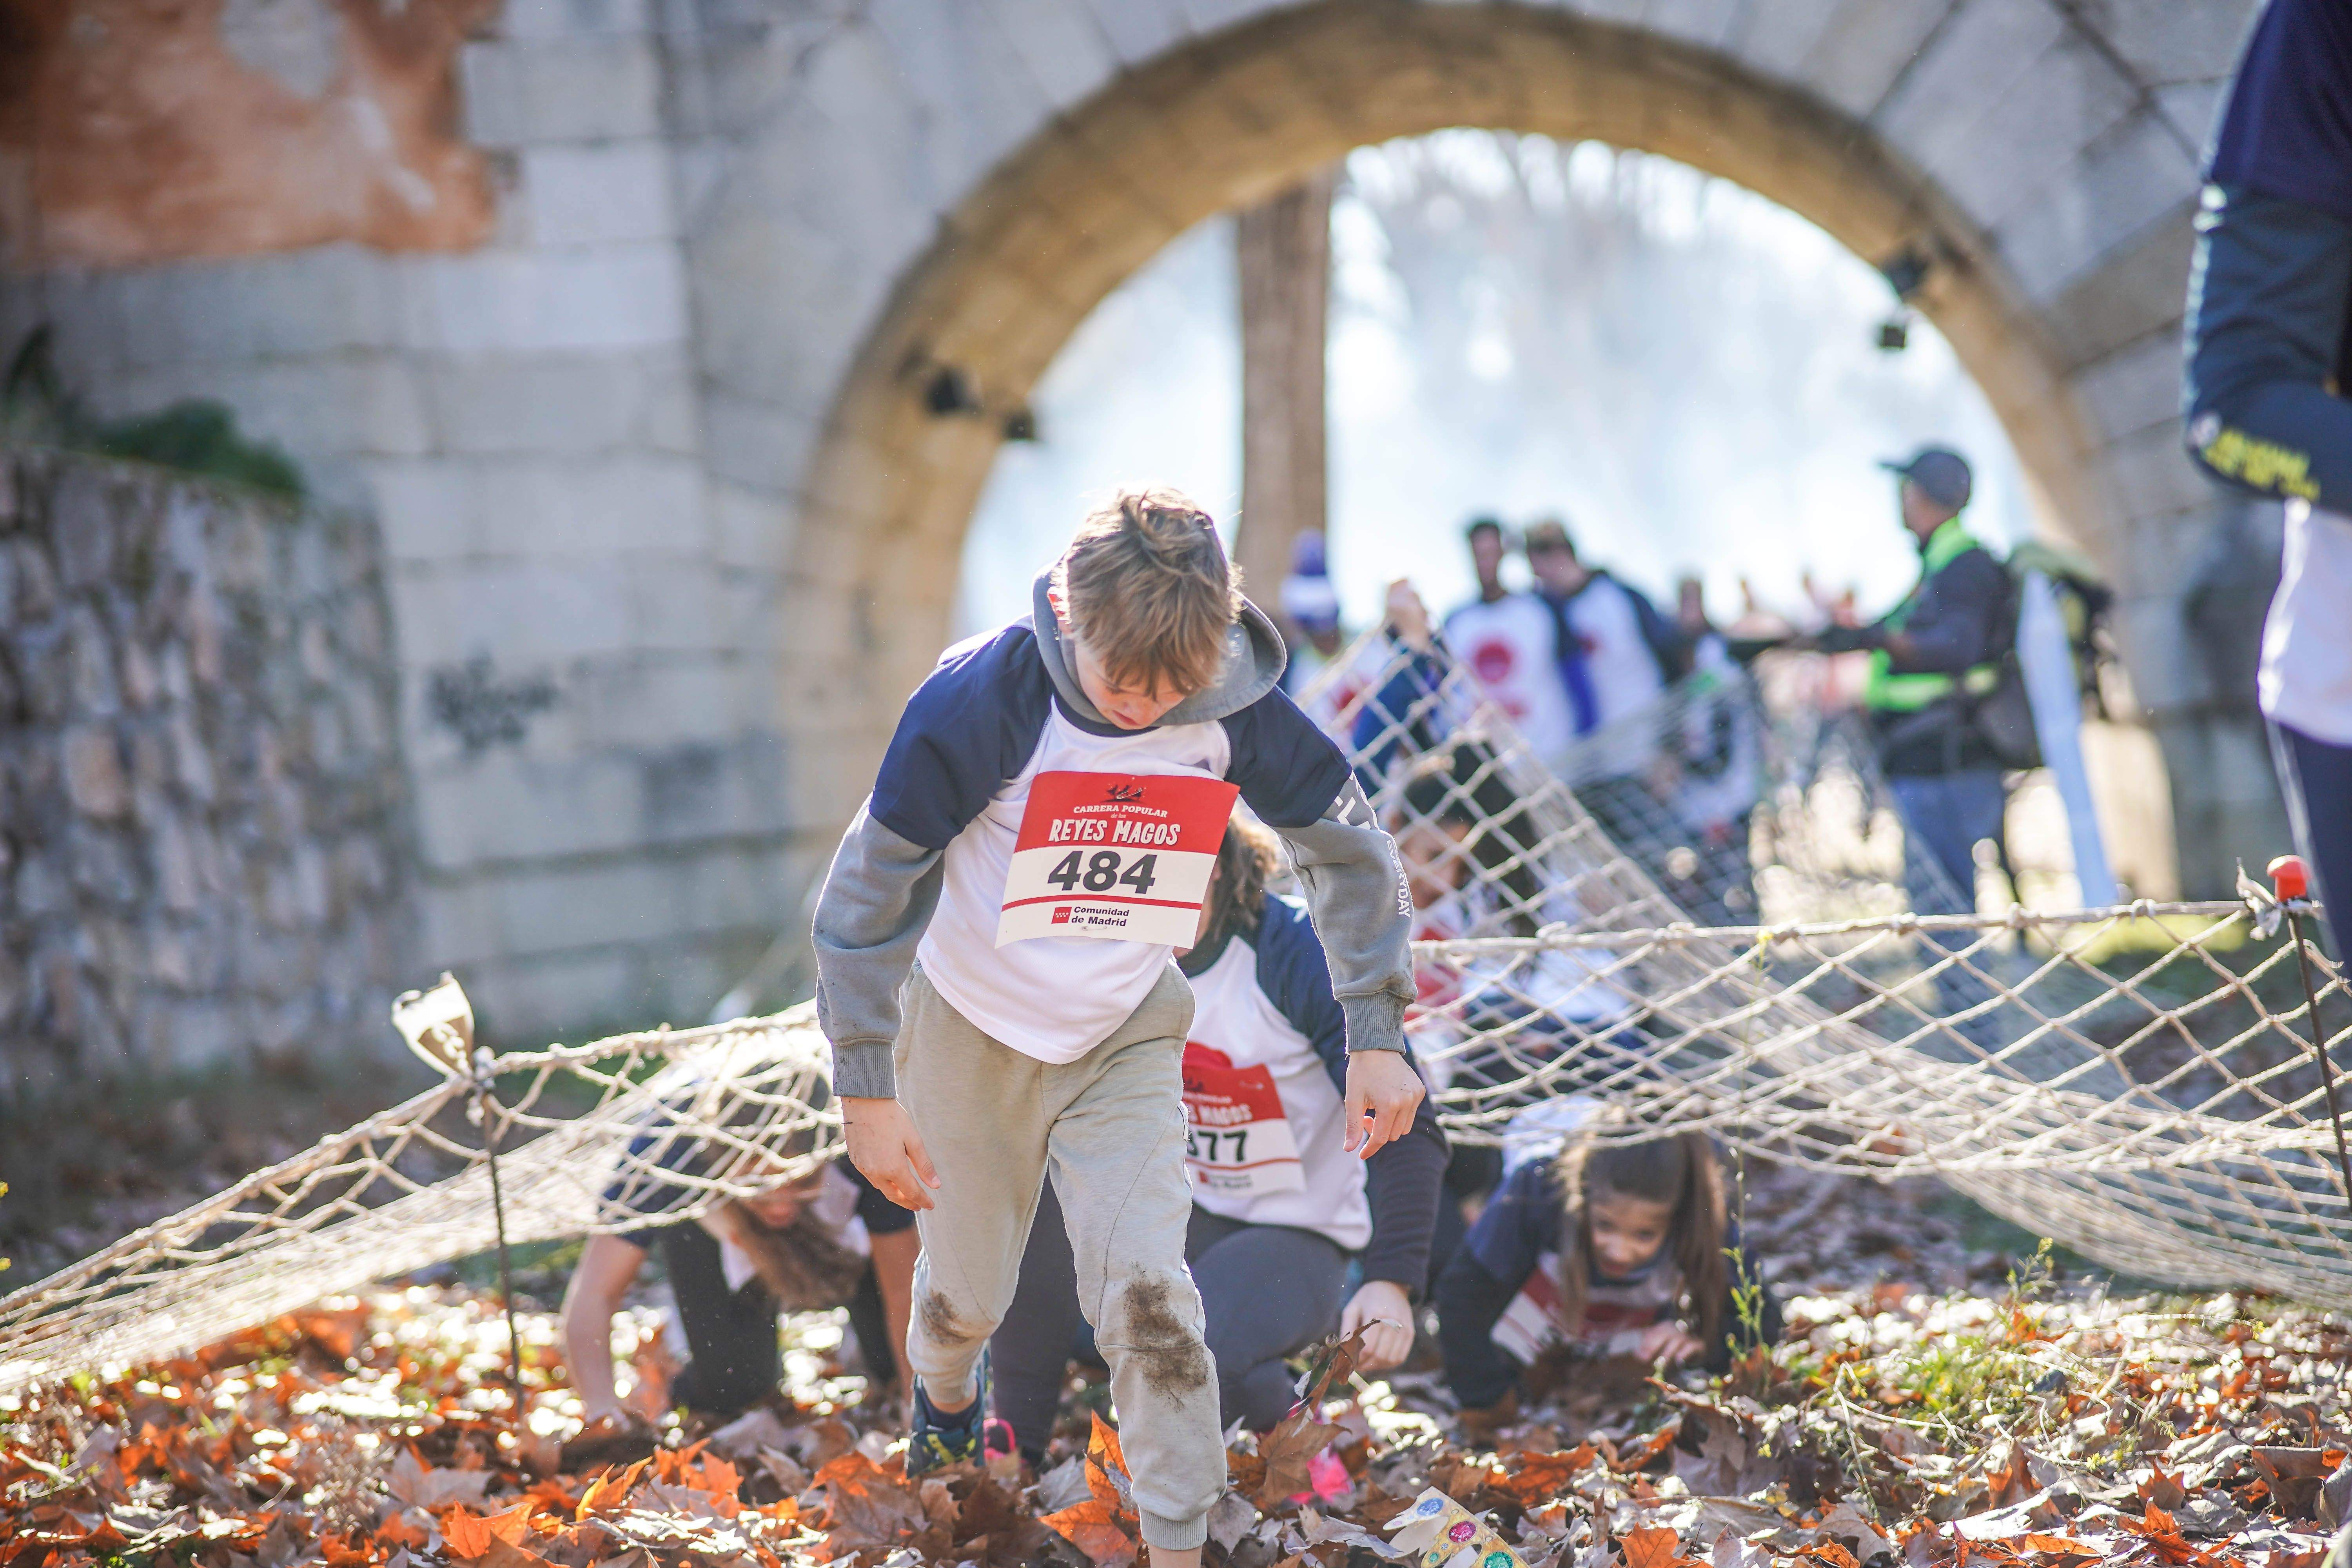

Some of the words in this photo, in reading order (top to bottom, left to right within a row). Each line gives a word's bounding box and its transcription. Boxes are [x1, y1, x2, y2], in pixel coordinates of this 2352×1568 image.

[1073, 805, 1119, 814] CARRERA
[1122, 805, 1168, 818] POPULAR
[1048, 818, 1107, 842] REYES
[1112, 820, 1181, 845] MAGOS
[1047, 851, 1158, 894] 484
[1386, 840, 1410, 918] EVERYDAY
[1074, 906, 1129, 916] Comunidad
[1088, 916, 1126, 926] Madrid
